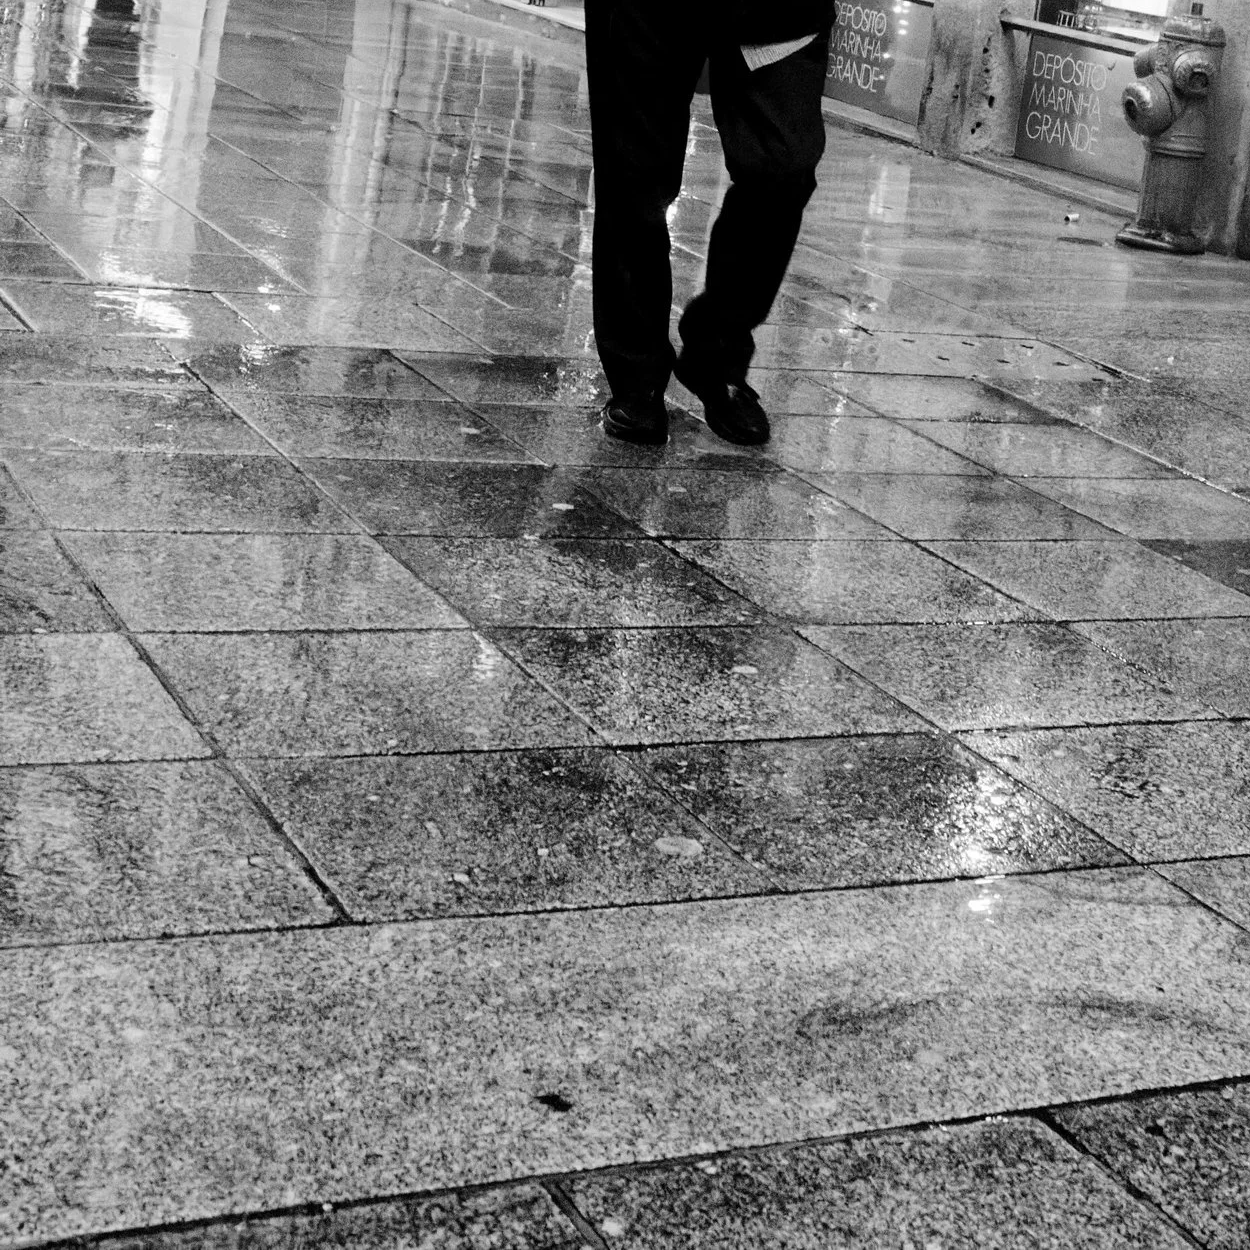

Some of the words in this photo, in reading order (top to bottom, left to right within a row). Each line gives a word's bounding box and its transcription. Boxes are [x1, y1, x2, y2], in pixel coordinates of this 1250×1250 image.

[1033, 51, 1107, 91] DEPÓSITO
[1029, 82, 1101, 124] MARINHA
[1026, 111, 1099, 156] GRANDE
